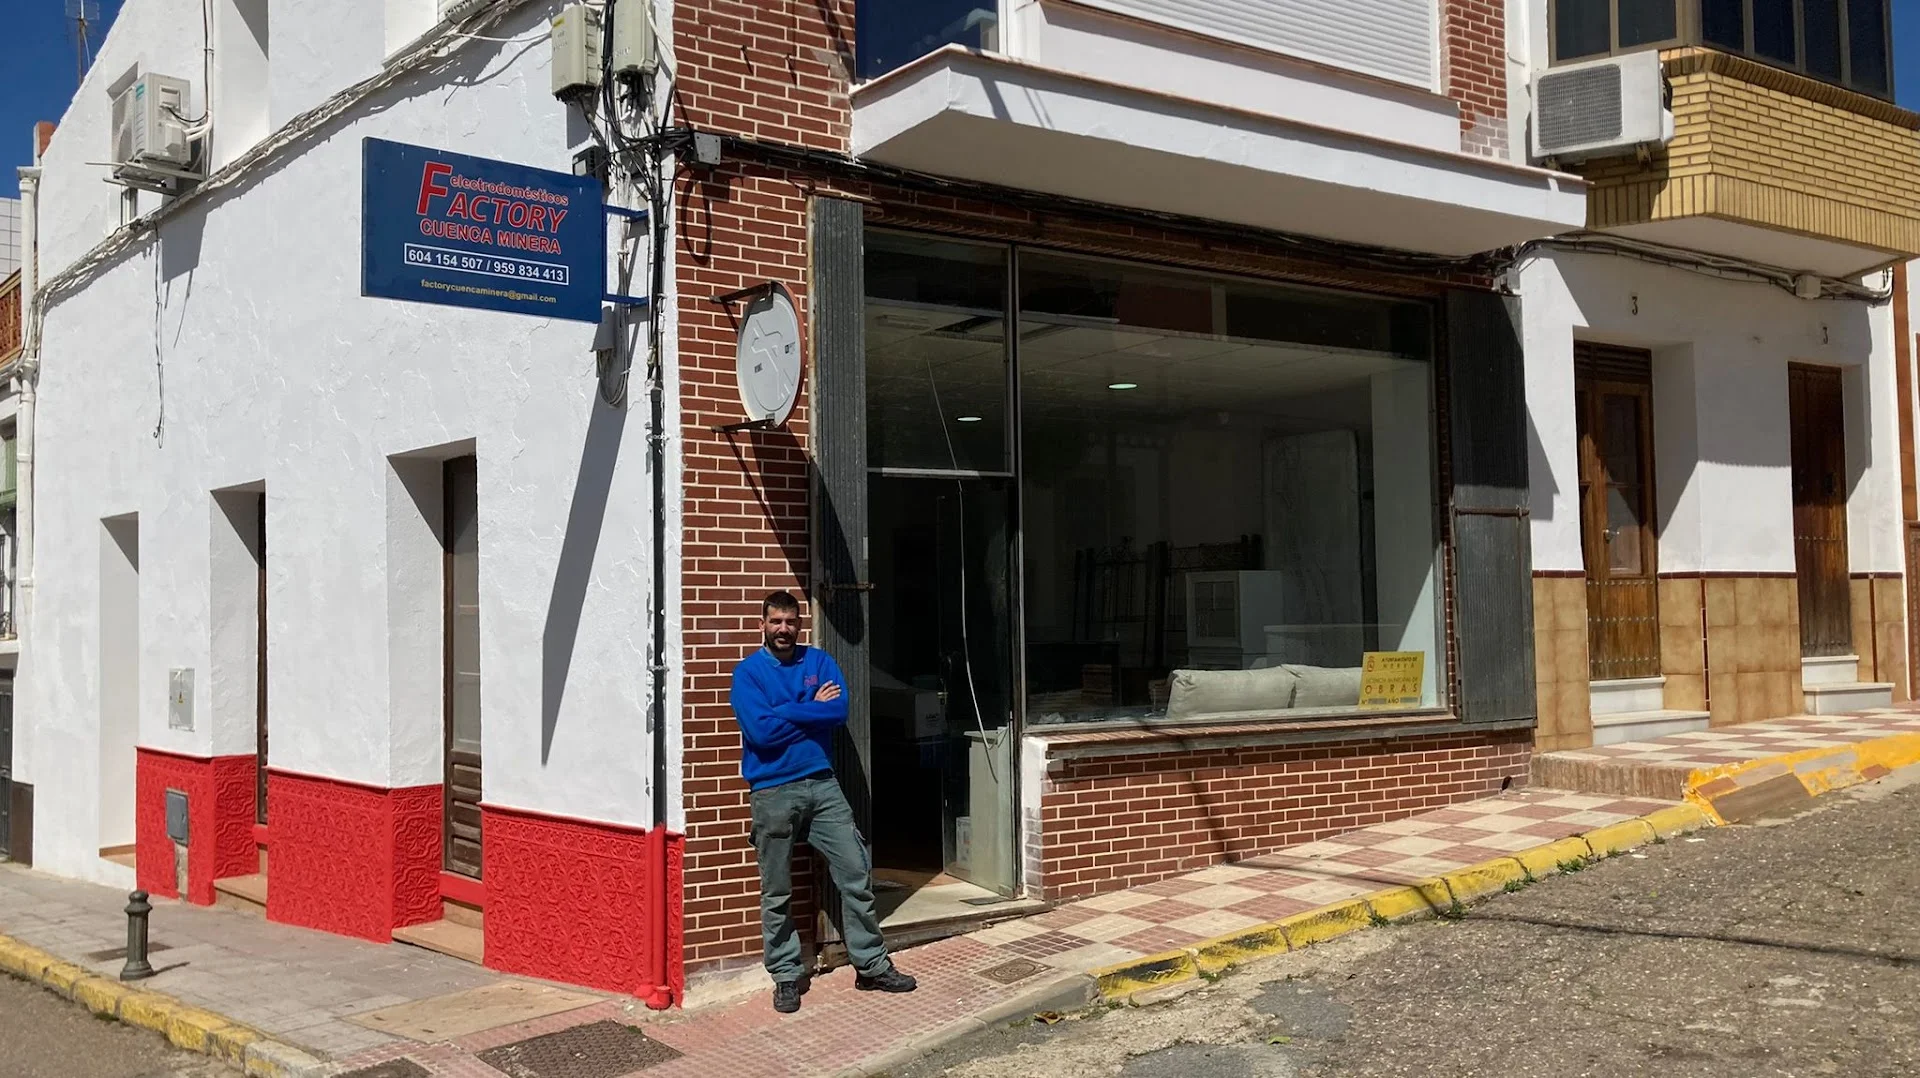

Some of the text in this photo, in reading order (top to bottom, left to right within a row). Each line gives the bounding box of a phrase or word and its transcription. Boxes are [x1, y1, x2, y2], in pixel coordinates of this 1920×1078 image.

[450, 174, 568, 206] electrodomésticos
[420, 218, 562, 255] CUENCA MINERA
[408, 249, 432, 263] 604
[436, 254, 458, 267] 154
[461, 258, 483, 270] 507
[494, 262, 515, 275] 959
[518, 266, 540, 278] 834
[543, 269, 564, 281] 413
[421, 278, 557, 304] factorycuencaminera@gmail.com
[1631, 295, 1639, 315] 3
[1365, 683, 1418, 694] OBRAS
